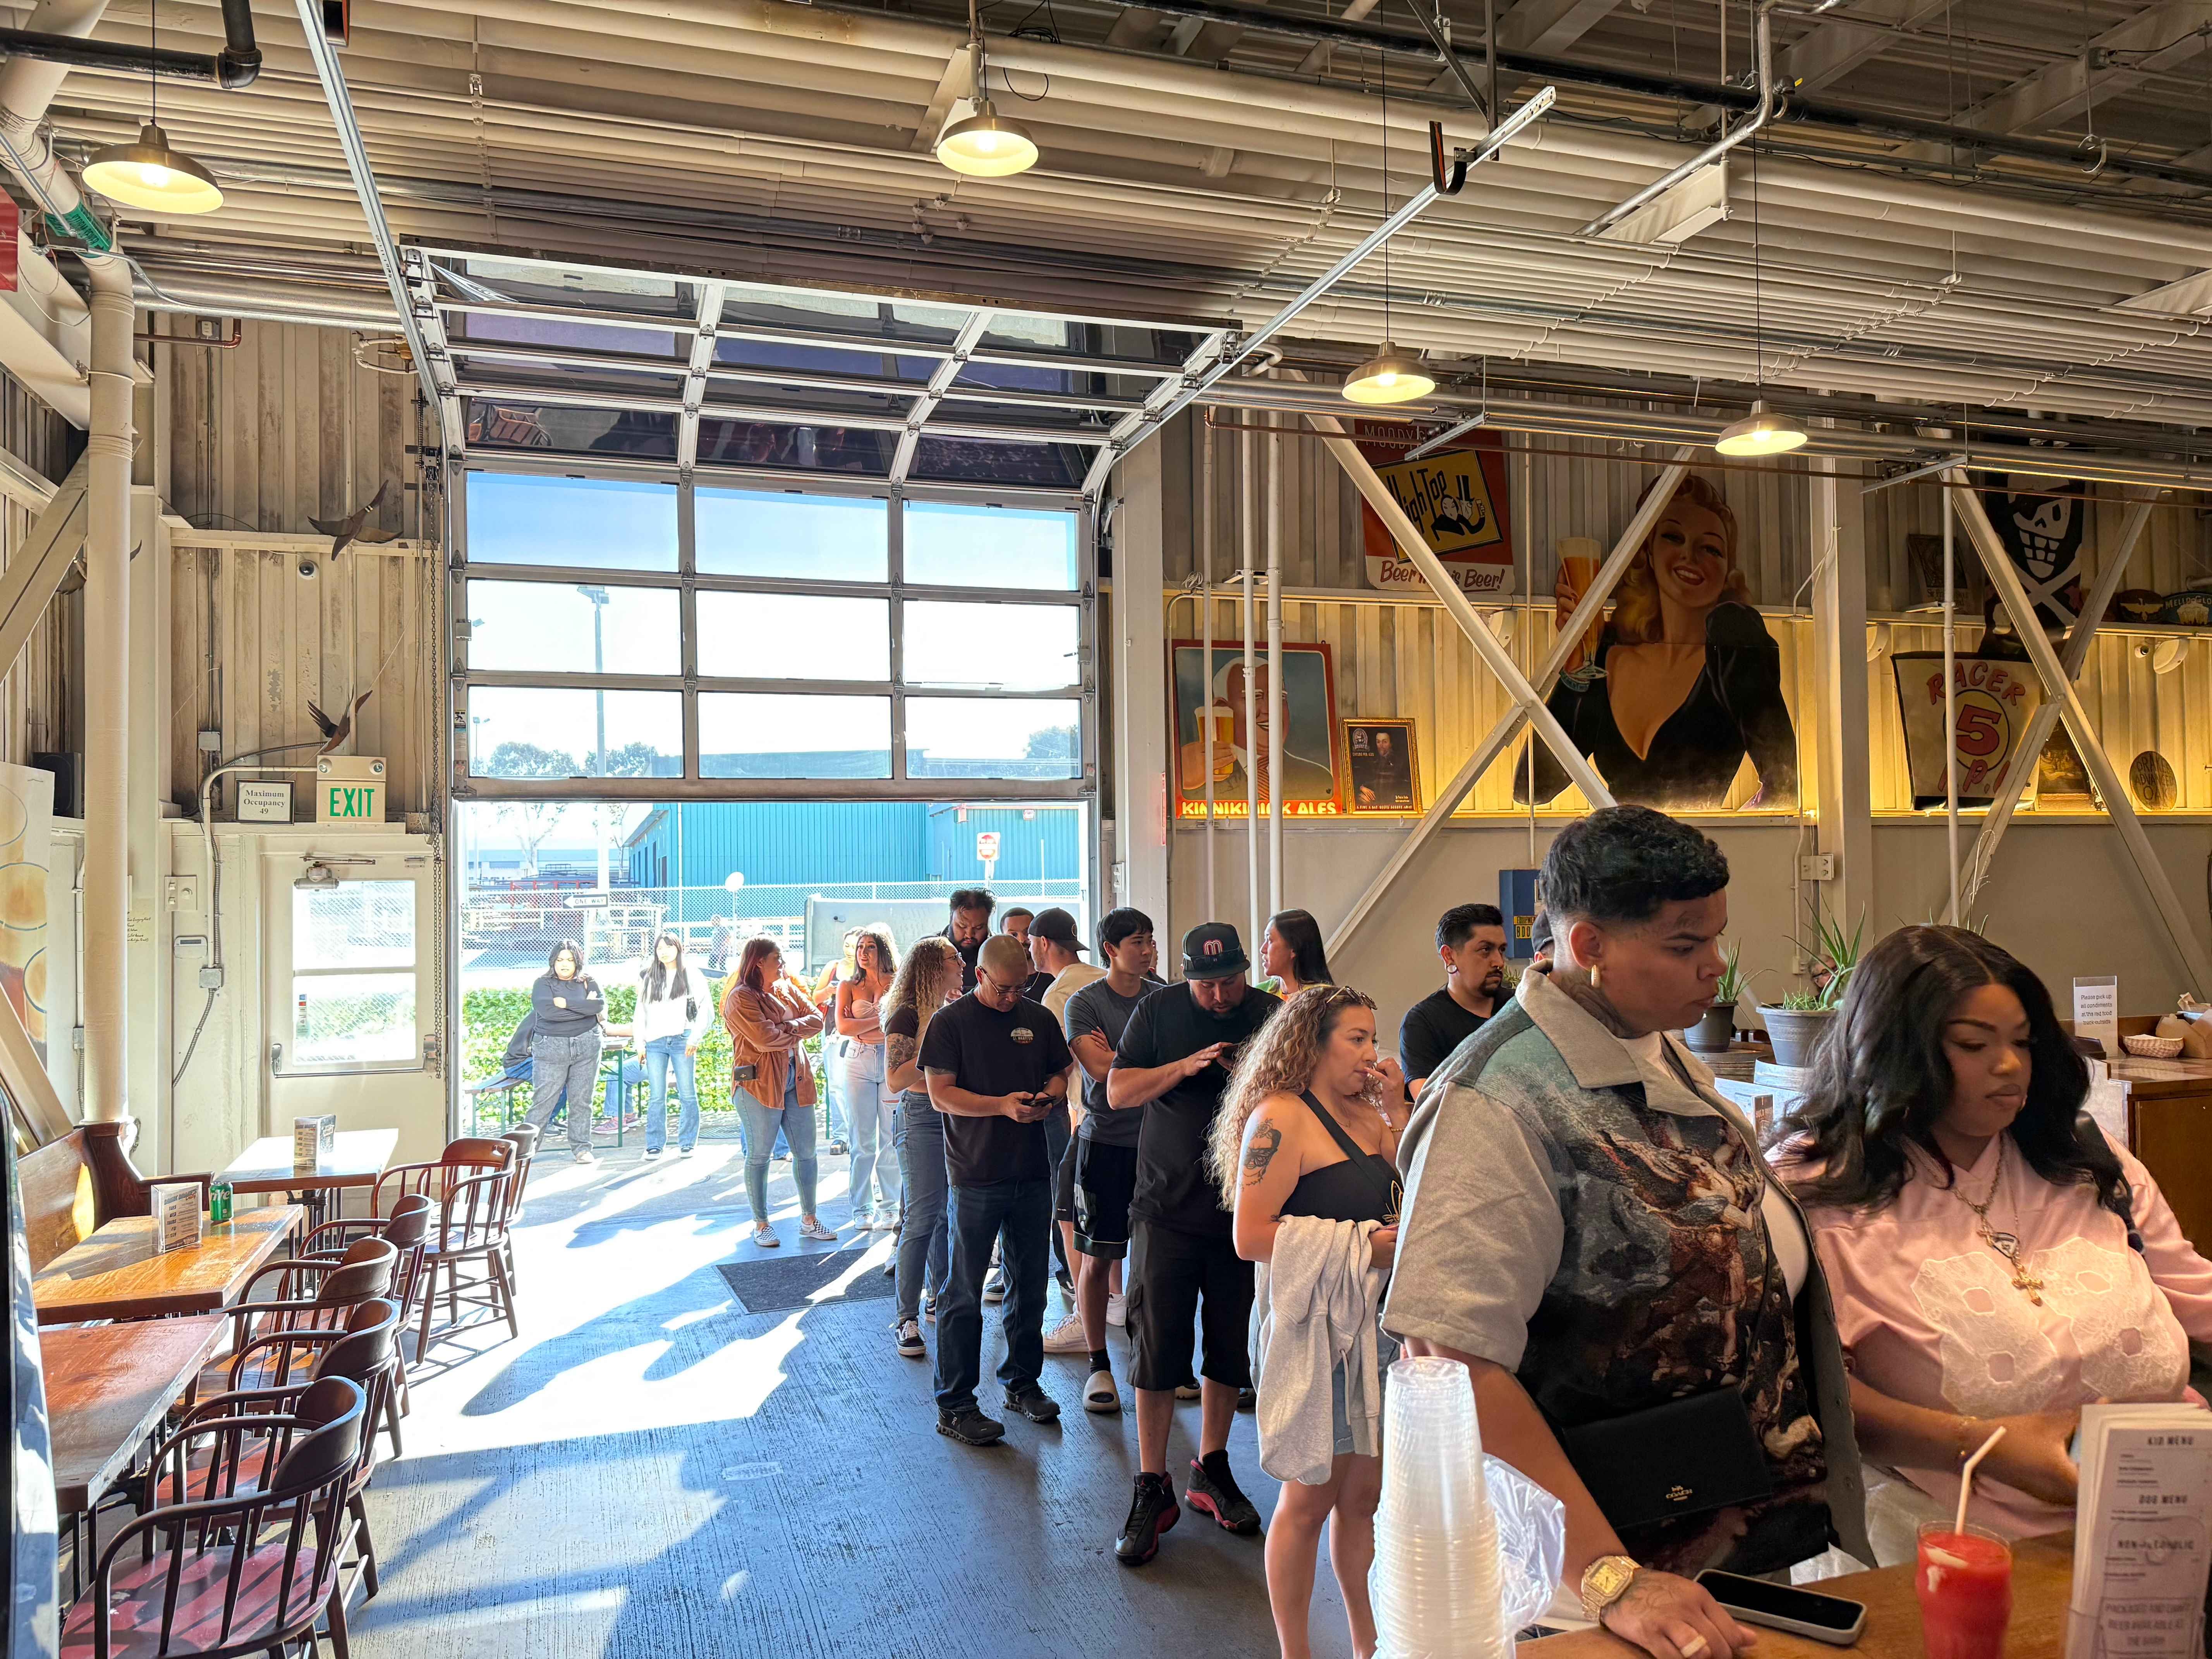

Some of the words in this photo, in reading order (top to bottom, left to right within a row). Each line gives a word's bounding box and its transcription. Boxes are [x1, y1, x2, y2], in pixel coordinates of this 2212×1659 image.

[1380, 560, 1416, 583] Beer
[1464, 568, 1505, 591] Beer!
[1927, 661, 2025, 706] RACER
[1956, 704, 2002, 756] 5
[245, 789, 284, 797] Maximum
[243, 799, 285, 807] Occupancy
[329, 788, 375, 817] EXIT
[1182, 801, 1291, 815] KINNIKIIK
[1297, 802, 1336, 814] ALES
[2148, 1437, 2164, 1446] KID
[2167, 1436, 2195, 1445] MENU
[2161, 1495, 2188, 1504] MENU
